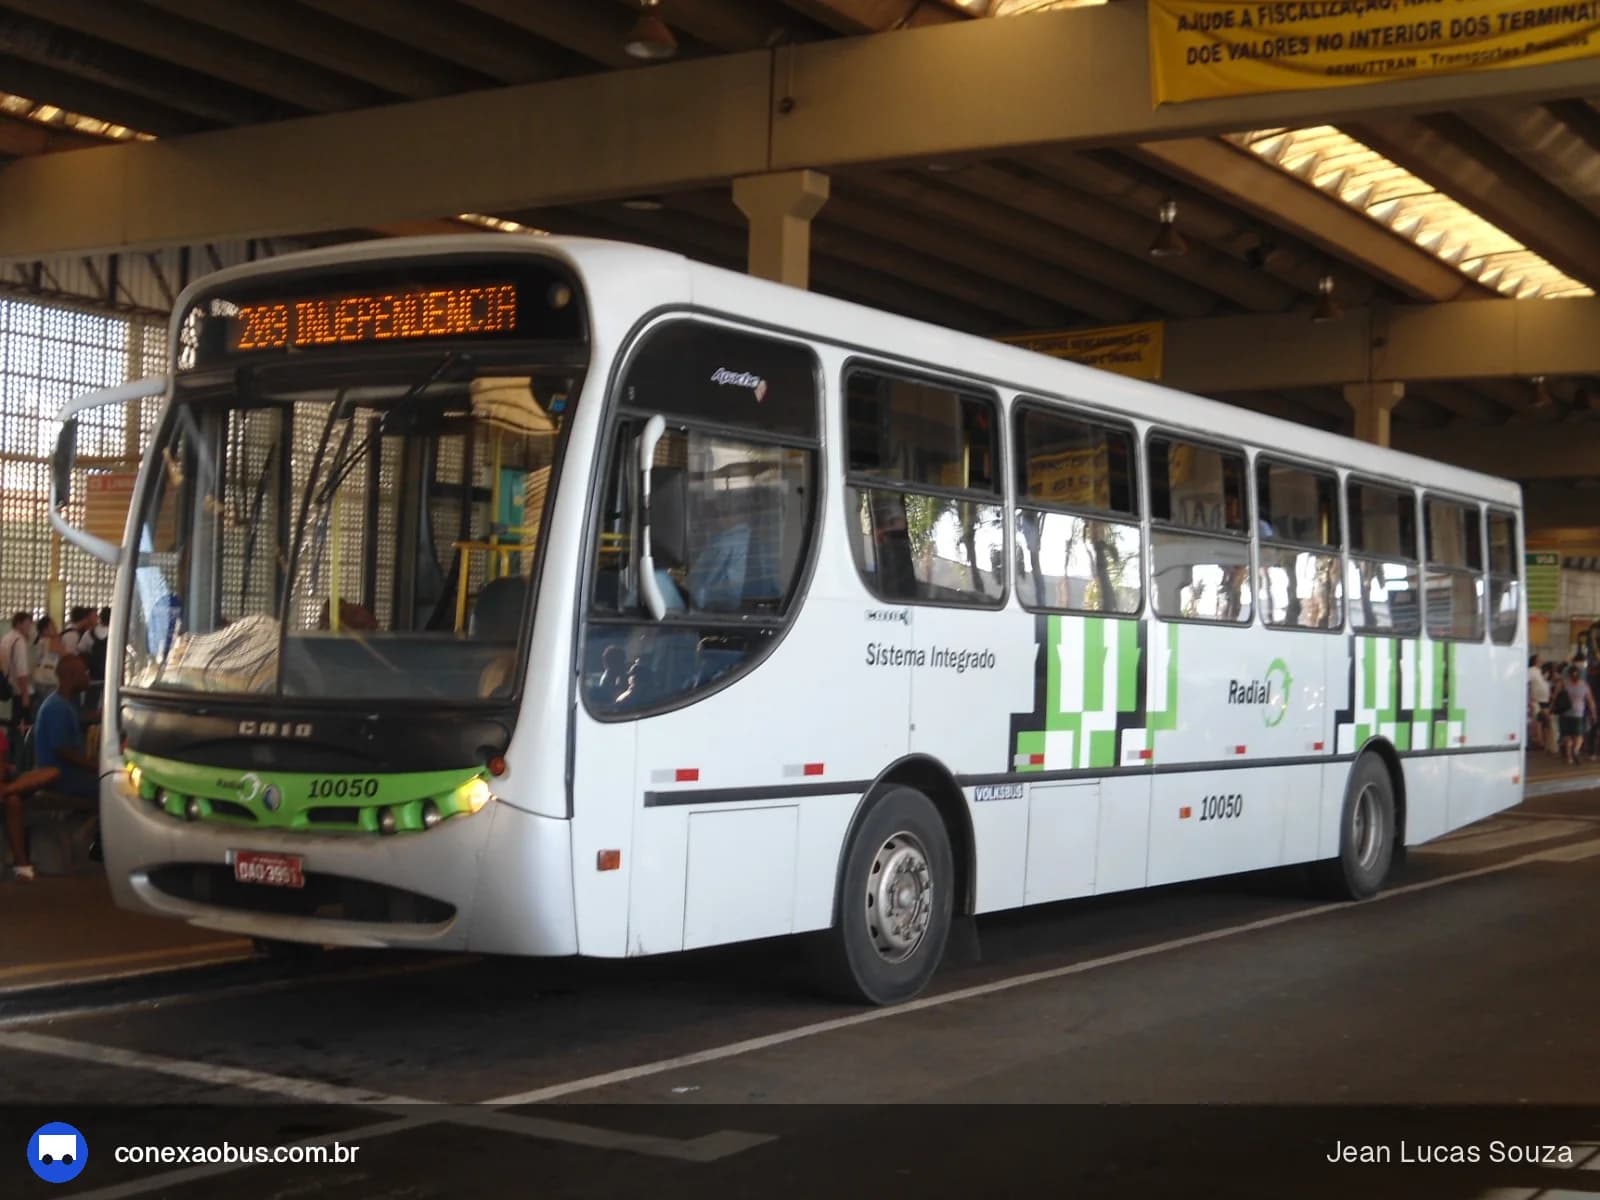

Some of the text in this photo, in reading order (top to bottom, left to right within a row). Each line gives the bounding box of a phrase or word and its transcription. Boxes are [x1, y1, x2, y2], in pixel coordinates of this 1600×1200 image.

[1177, 11, 1235, 32] AJUDE
[1241, 9, 1253, 28] A
[1186, 44, 1222, 65] DOE
[1227, 36, 1310, 60] VALORES
[1316, 33, 1343, 53] NO
[1349, 20, 1442, 48] INTERIOR
[1451, 15, 1490, 38] DOS
[865, 642, 996, 673] Sistema Integrado
[1228, 679, 1271, 704] Radial
[239, 721, 313, 736] CAIO
[308, 778, 379, 798] 10050
[1200, 794, 1243, 822] 10050
